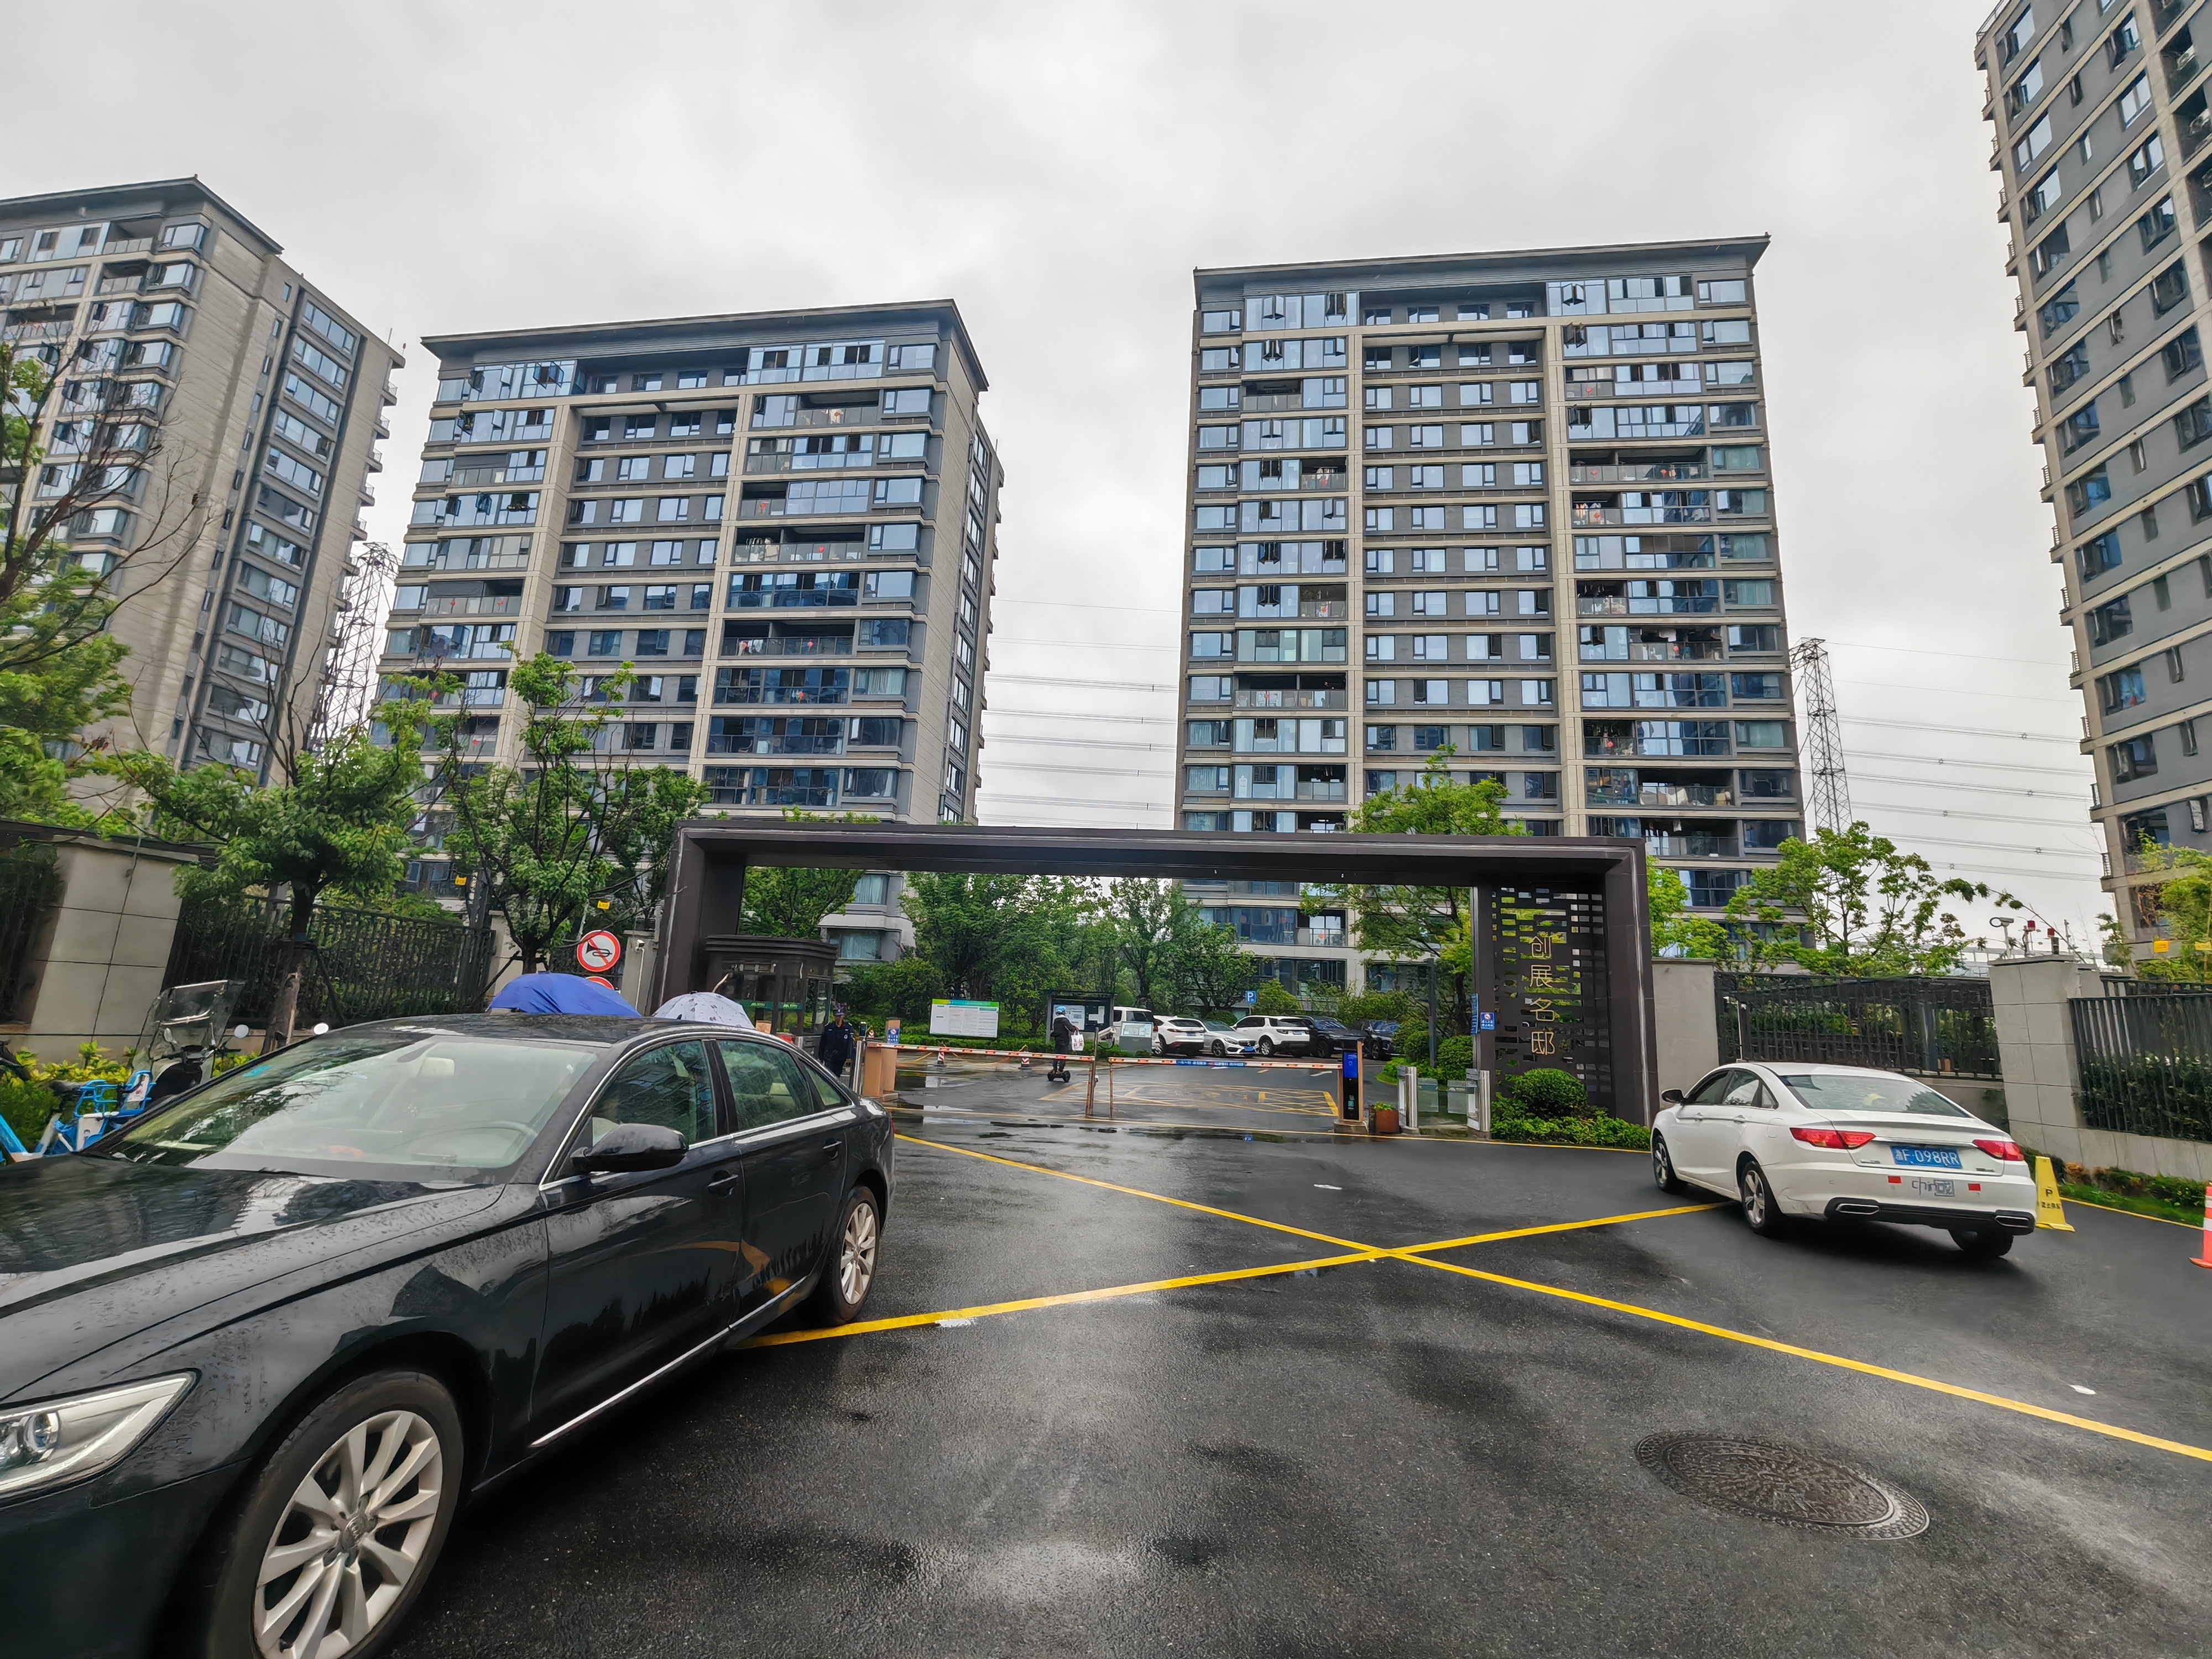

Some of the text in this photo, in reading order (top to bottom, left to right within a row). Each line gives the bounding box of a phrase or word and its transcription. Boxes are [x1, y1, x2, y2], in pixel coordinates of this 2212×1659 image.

[1247, 992, 1254, 1001] P
[1528, 935, 1556, 1056] 创展名邸
[2045, 1188, 2053, 1197] P
